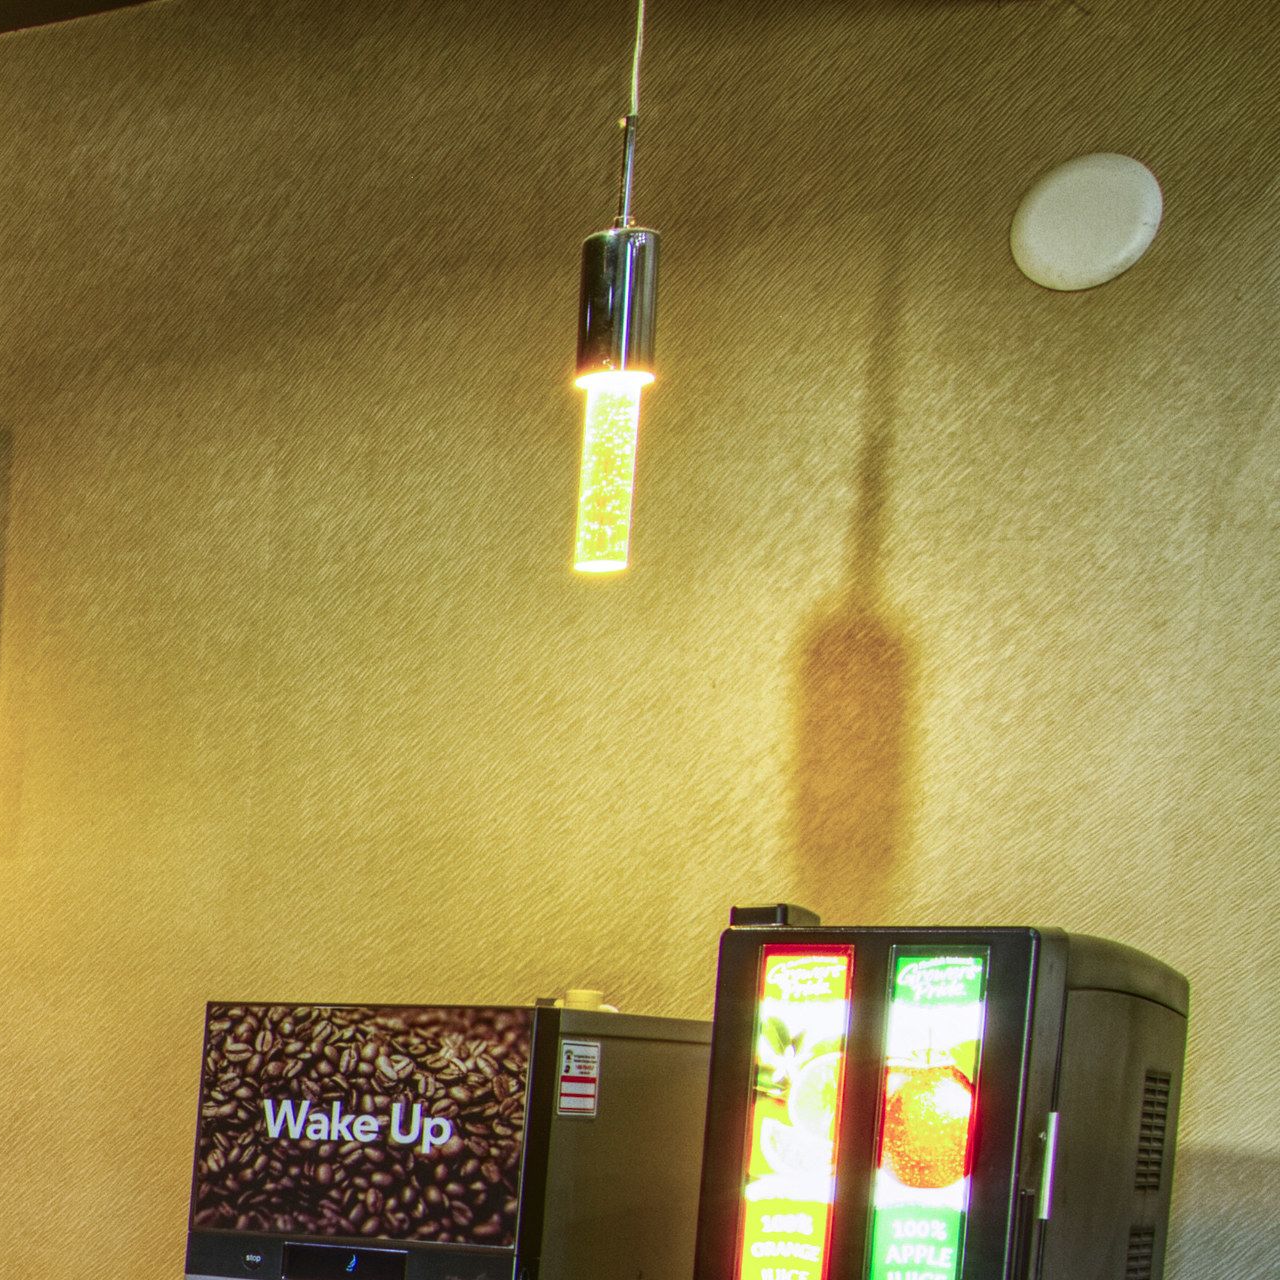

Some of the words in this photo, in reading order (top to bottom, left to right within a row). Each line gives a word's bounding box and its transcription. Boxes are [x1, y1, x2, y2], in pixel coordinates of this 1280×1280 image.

[263, 1099, 380, 1143] Wake
[391, 1103, 453, 1154] Up
[892, 1219, 948, 1241] 100%
[246, 1254, 261, 1262] stop
[750, 1241, 821, 1262] ORANGE
[885, 1243, 953, 1268] APPLE
